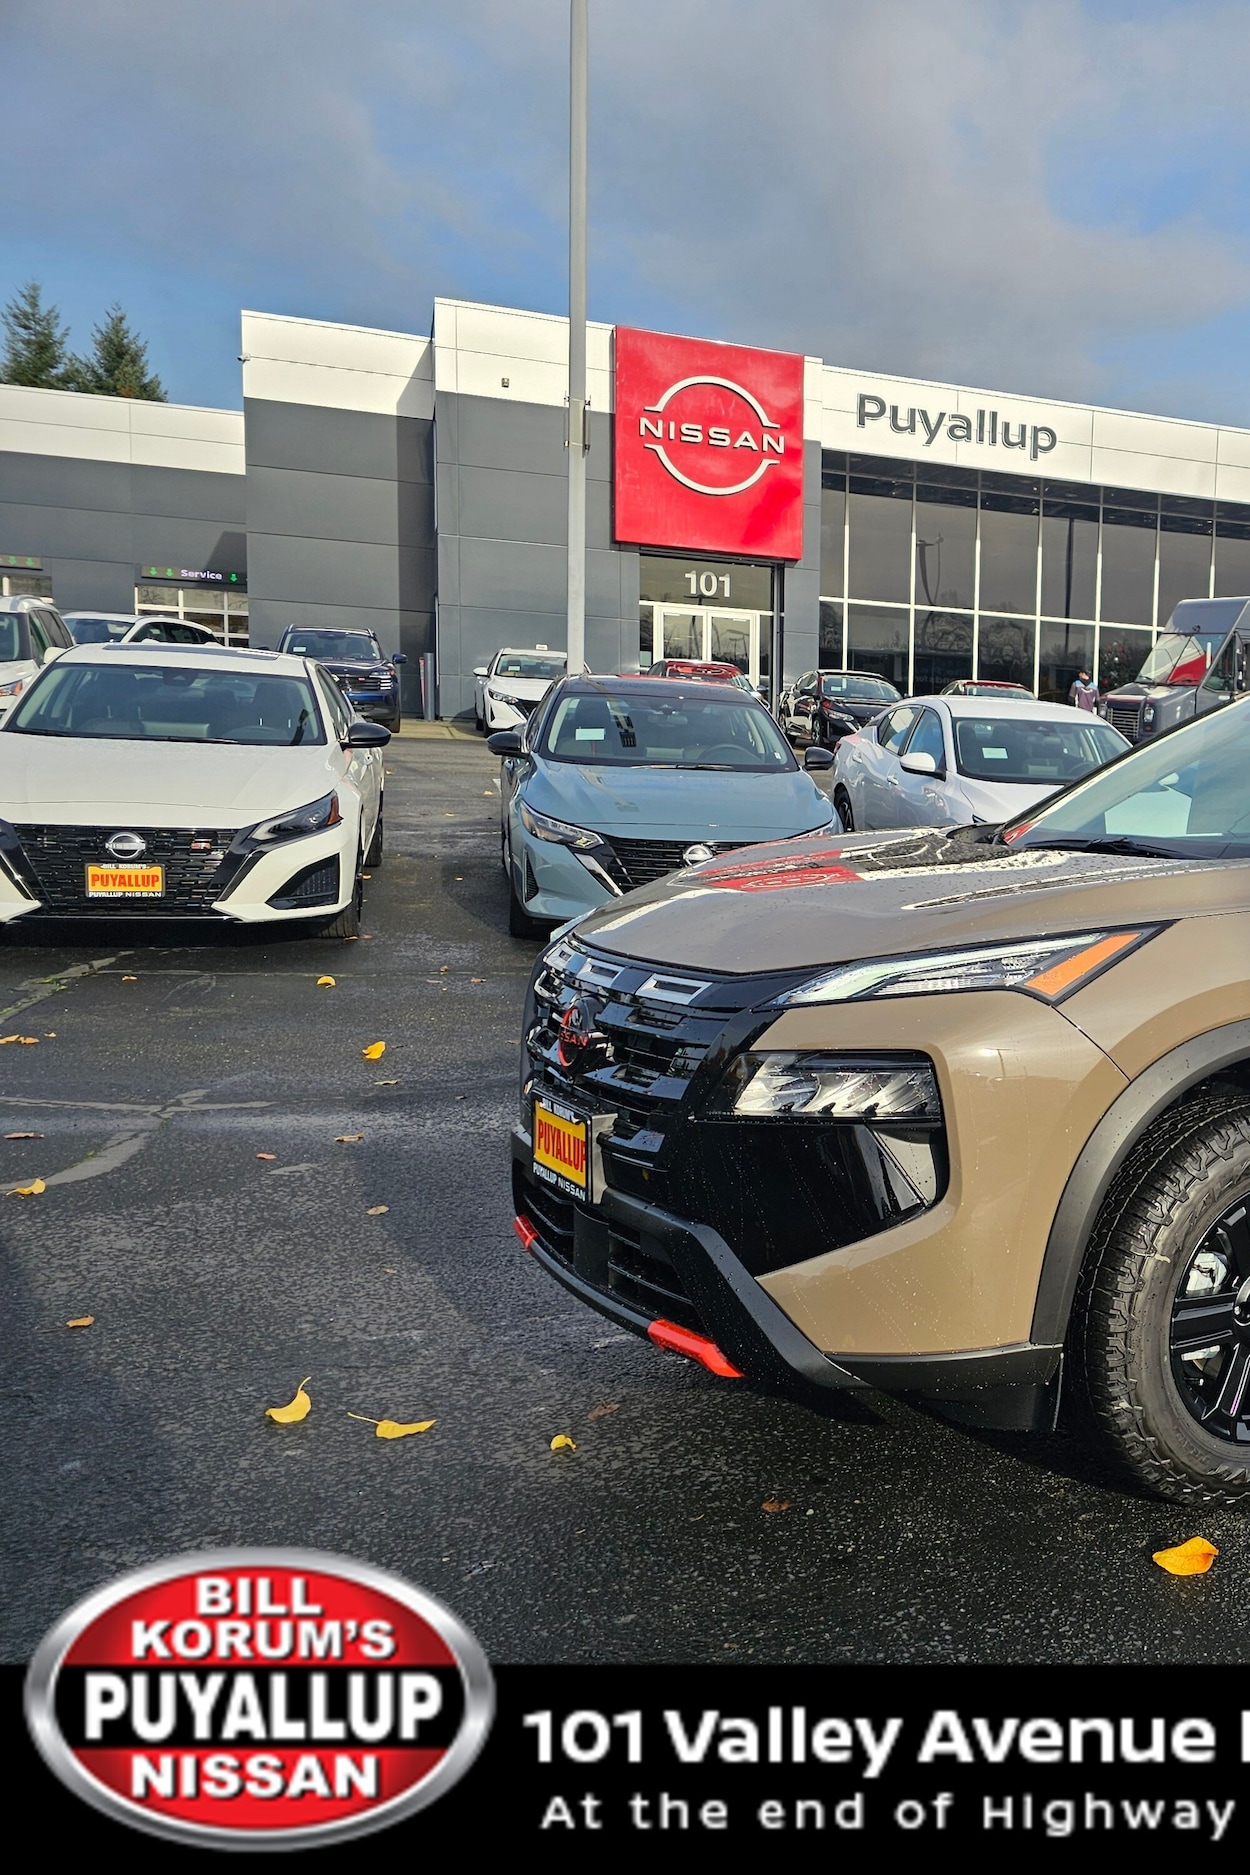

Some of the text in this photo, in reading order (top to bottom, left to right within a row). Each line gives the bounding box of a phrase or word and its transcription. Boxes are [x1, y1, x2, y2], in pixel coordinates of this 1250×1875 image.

[638, 416, 785, 455] NISSAN
[857, 393, 1058, 462] Puyallup
[180, 568, 223, 581] Service
[684, 570, 731, 598] 101
[90, 873, 160, 888] PUYALLUP
[537, 1118, 587, 1174] PUYALLUP
[557, 1176, 587, 1202] NISSAN
